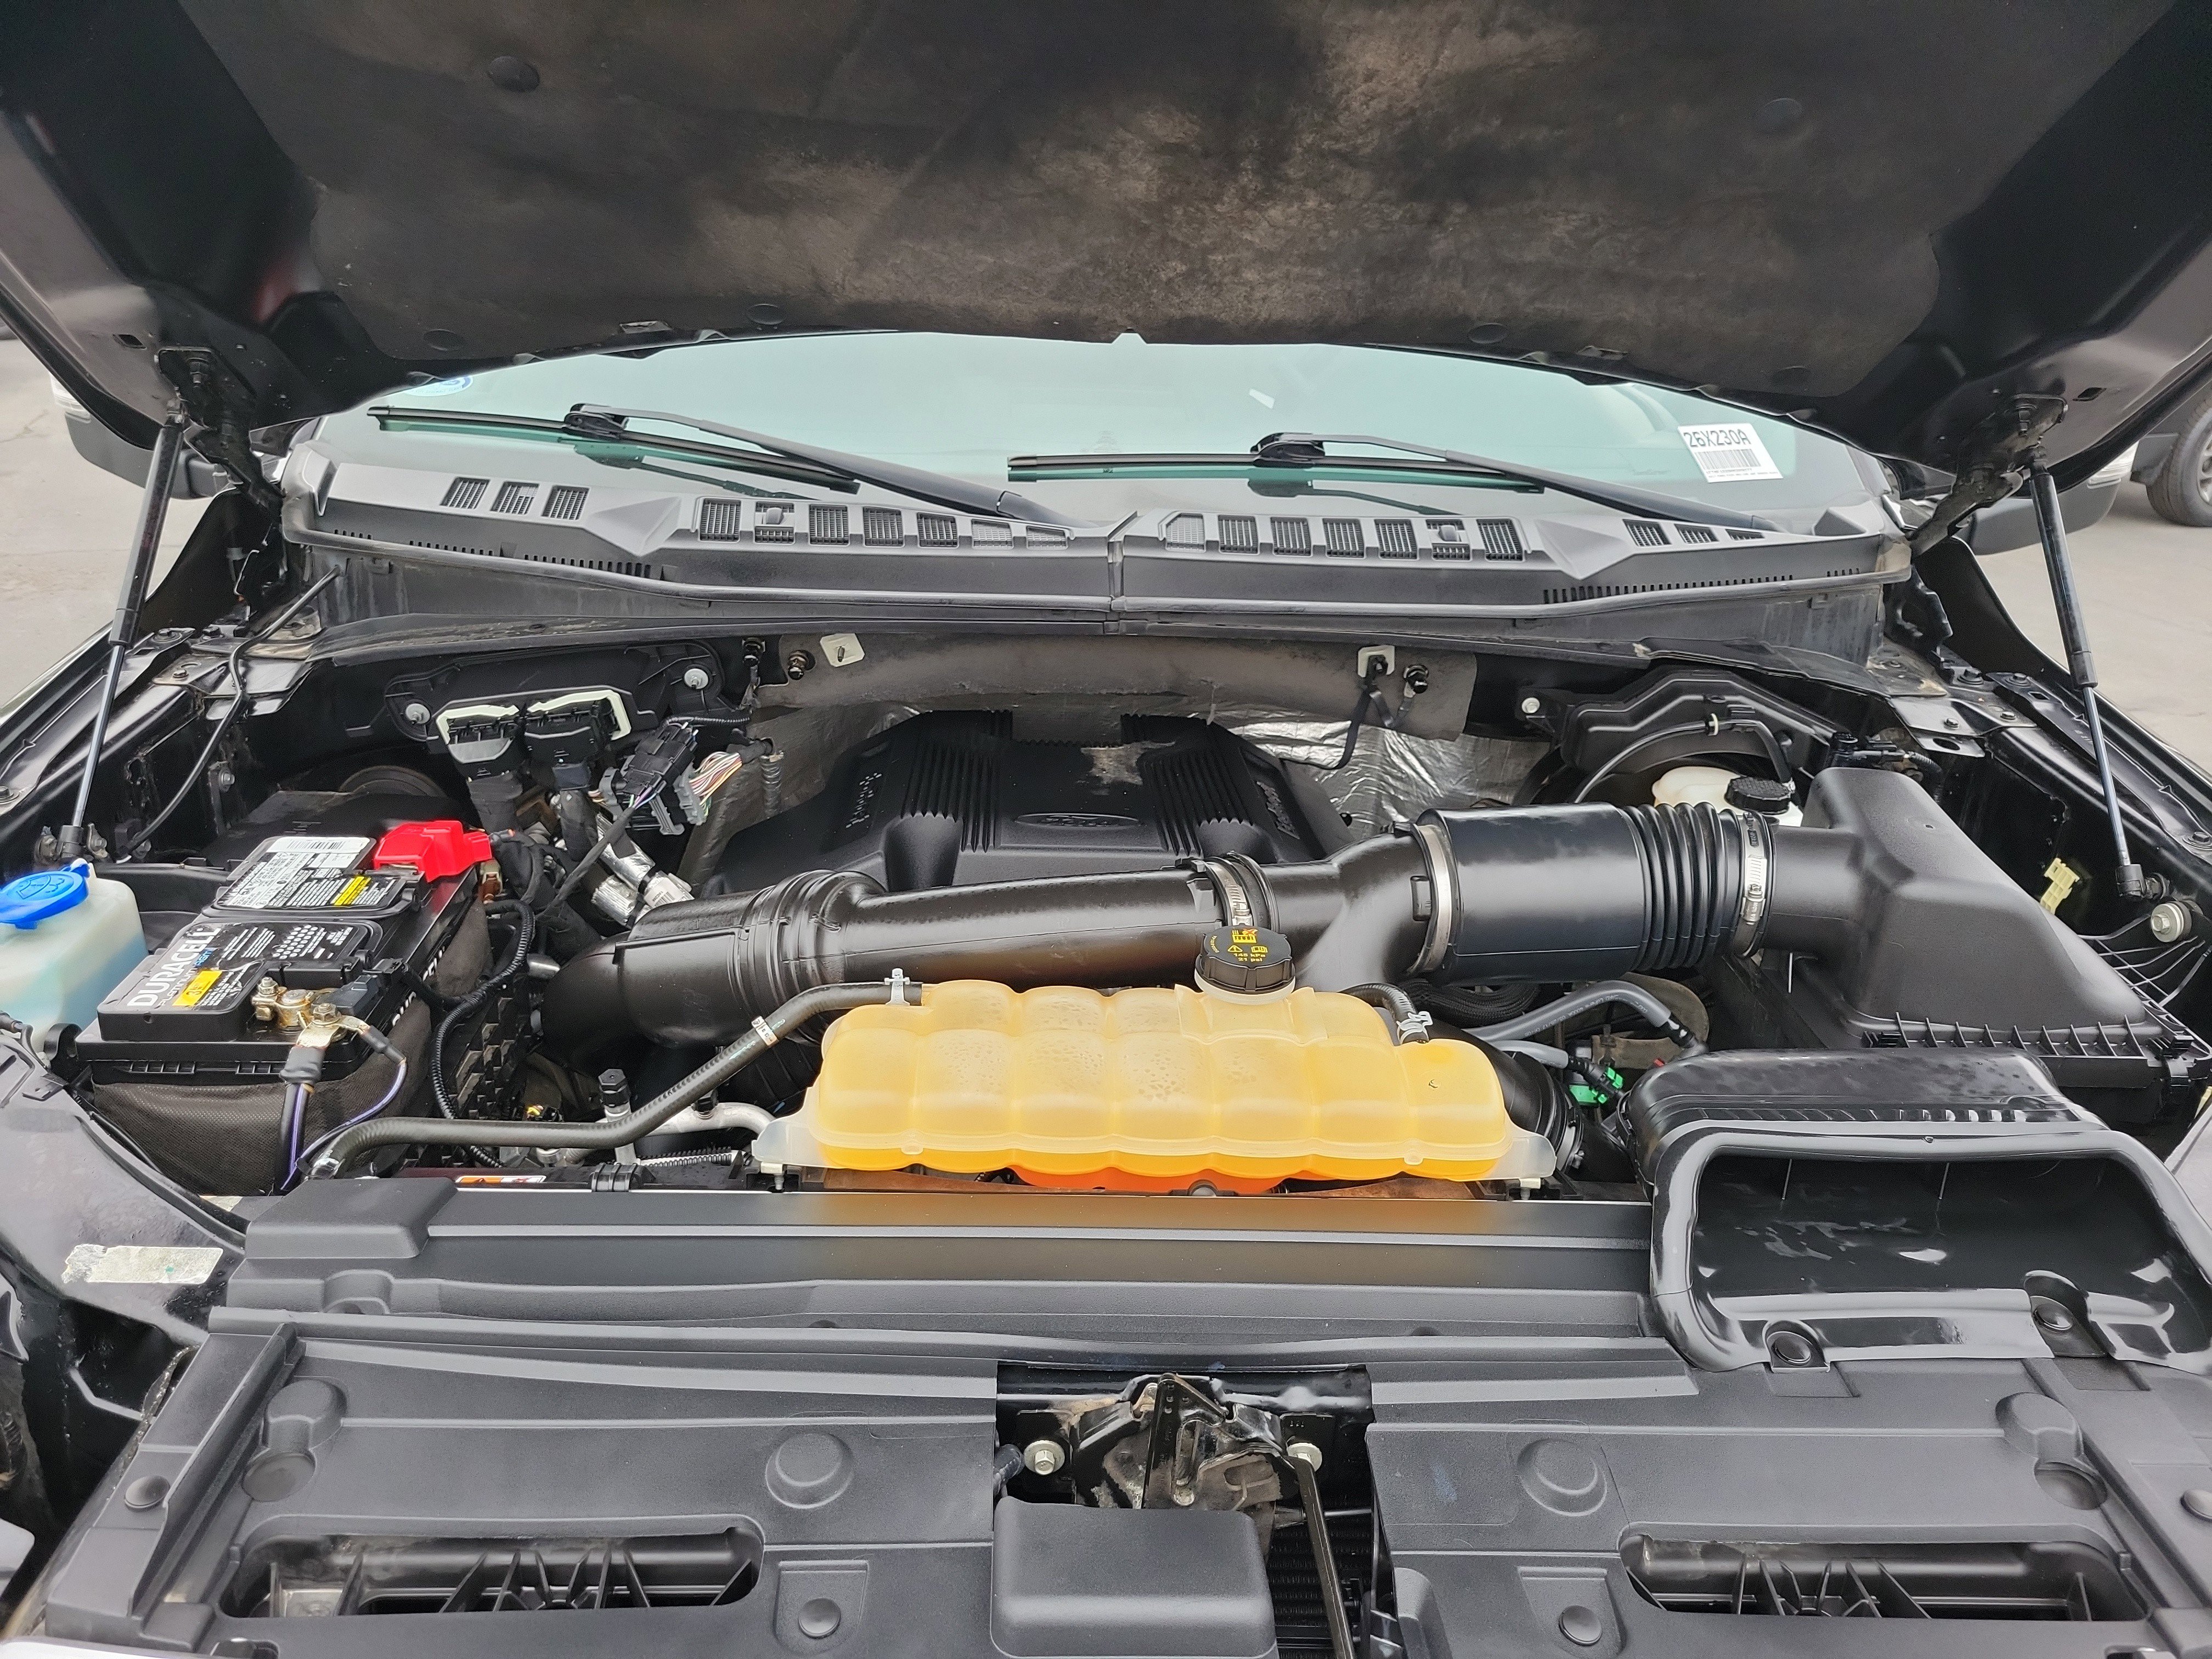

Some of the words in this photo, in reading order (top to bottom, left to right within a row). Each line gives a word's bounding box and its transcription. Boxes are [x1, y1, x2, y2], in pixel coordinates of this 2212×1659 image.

[1683, 429, 1751, 447] 26X230A
[127, 928, 222, 1006] DURACELL
[158, 968, 198, 1006] PLATINUM
[194, 950, 213, 967] AGM
